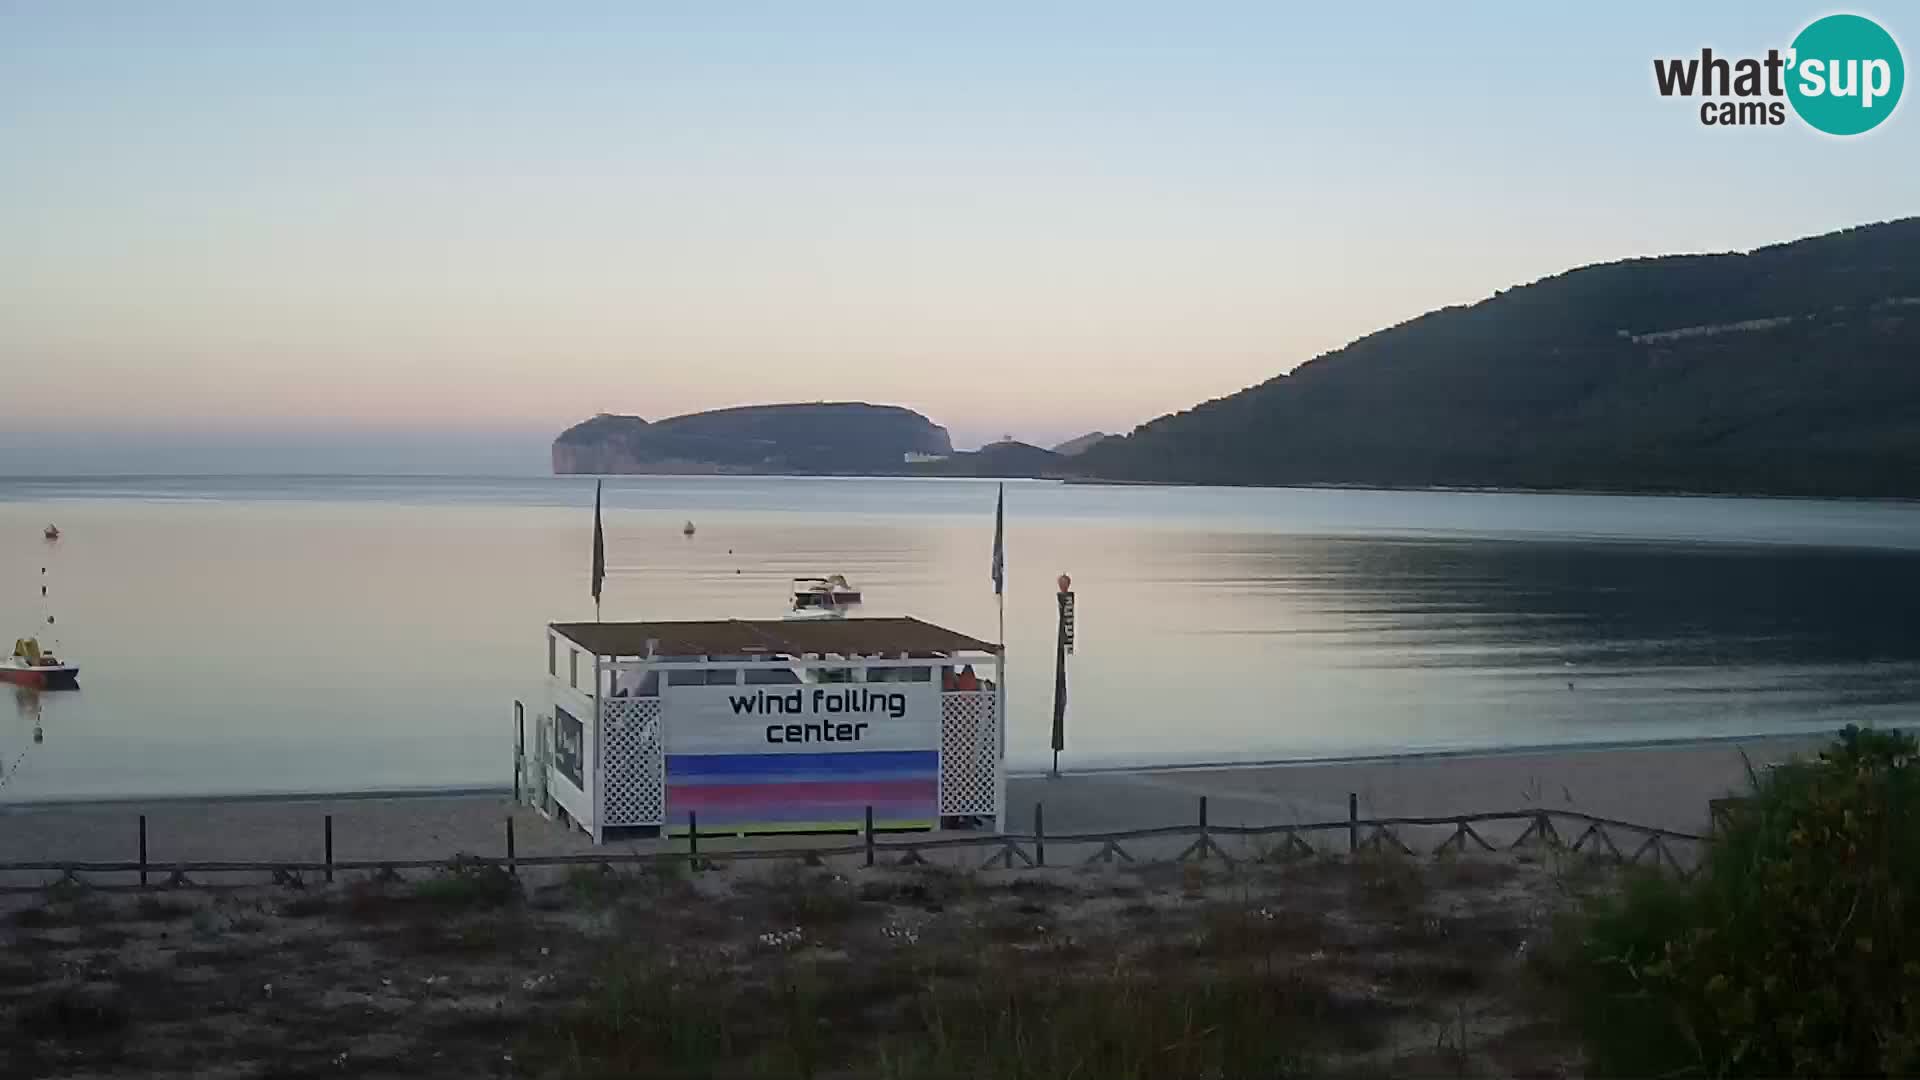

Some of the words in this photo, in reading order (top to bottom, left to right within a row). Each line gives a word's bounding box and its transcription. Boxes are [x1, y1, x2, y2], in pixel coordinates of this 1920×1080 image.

[728, 689, 802, 715] wind
[812, 688, 906, 718] foiling
[766, 719, 869, 744] center
